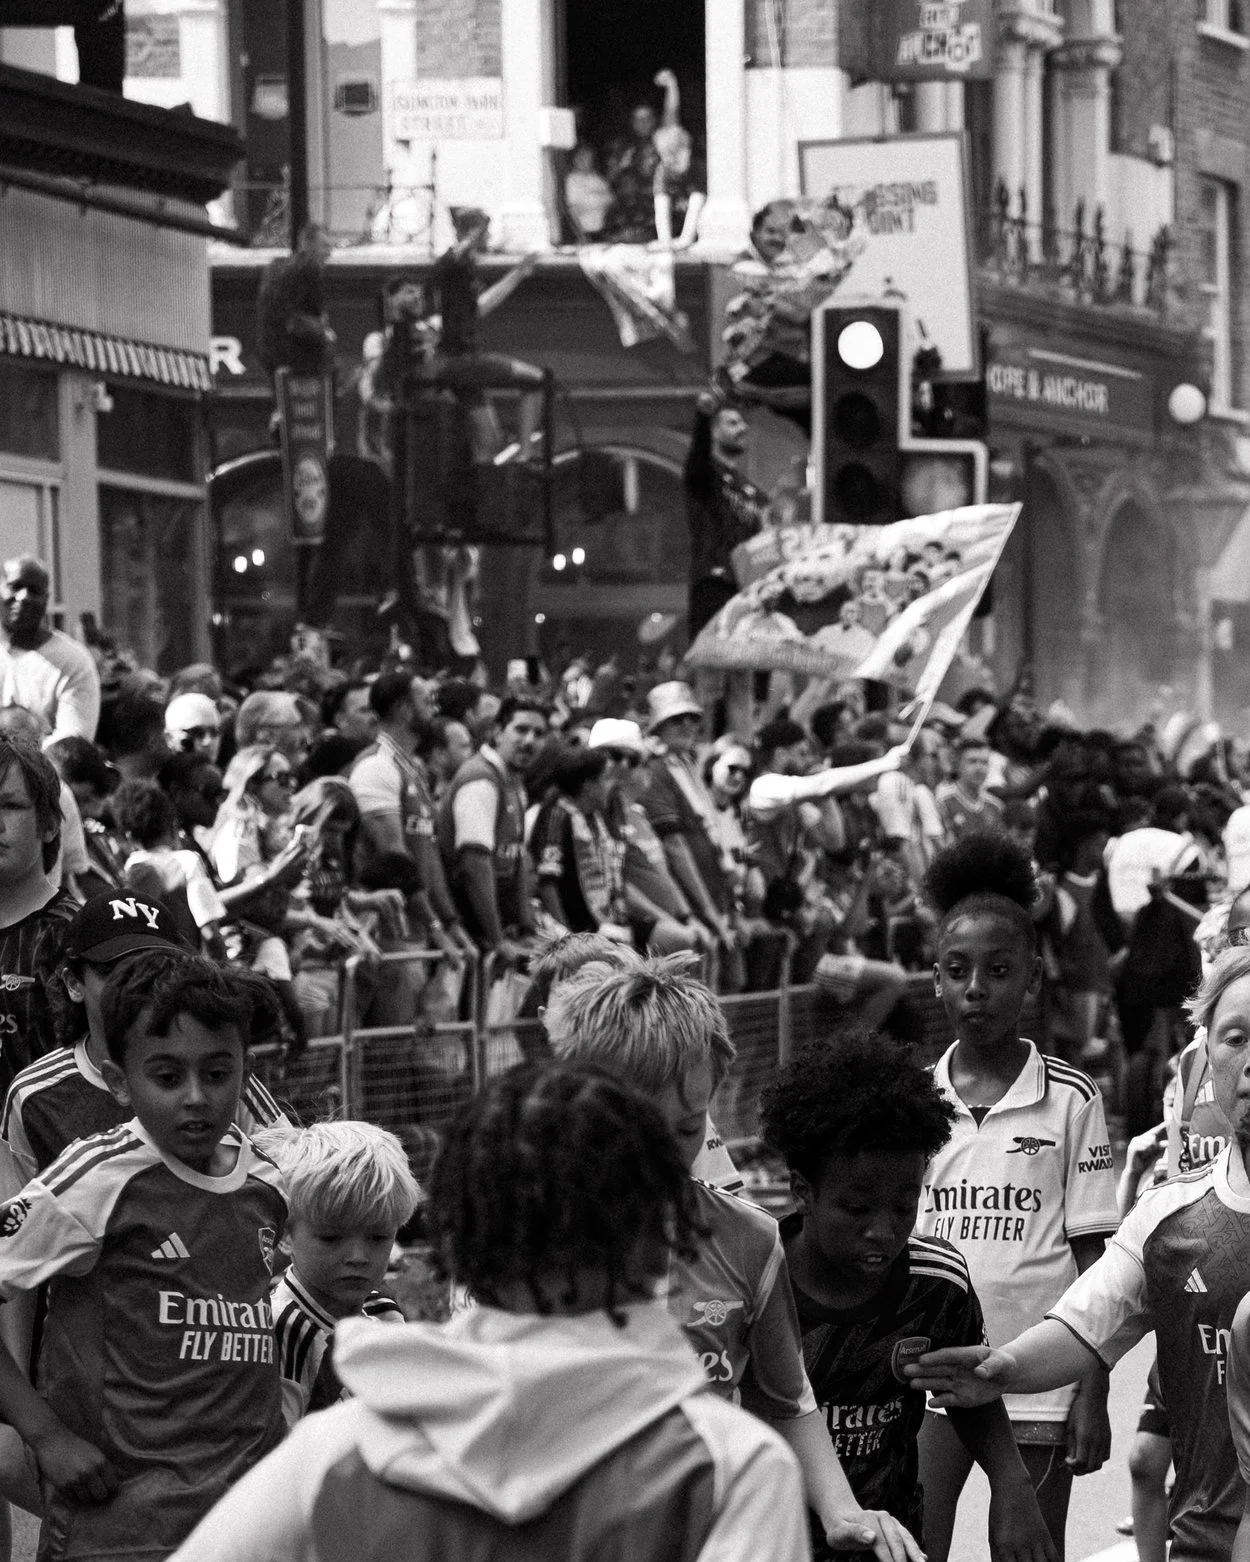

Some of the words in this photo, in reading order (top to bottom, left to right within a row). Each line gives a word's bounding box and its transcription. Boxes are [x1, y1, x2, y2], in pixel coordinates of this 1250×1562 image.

[108, 897, 160, 930] NY
[959, 1216, 1025, 1241] BETTER
[179, 1330, 217, 1360] FLY
